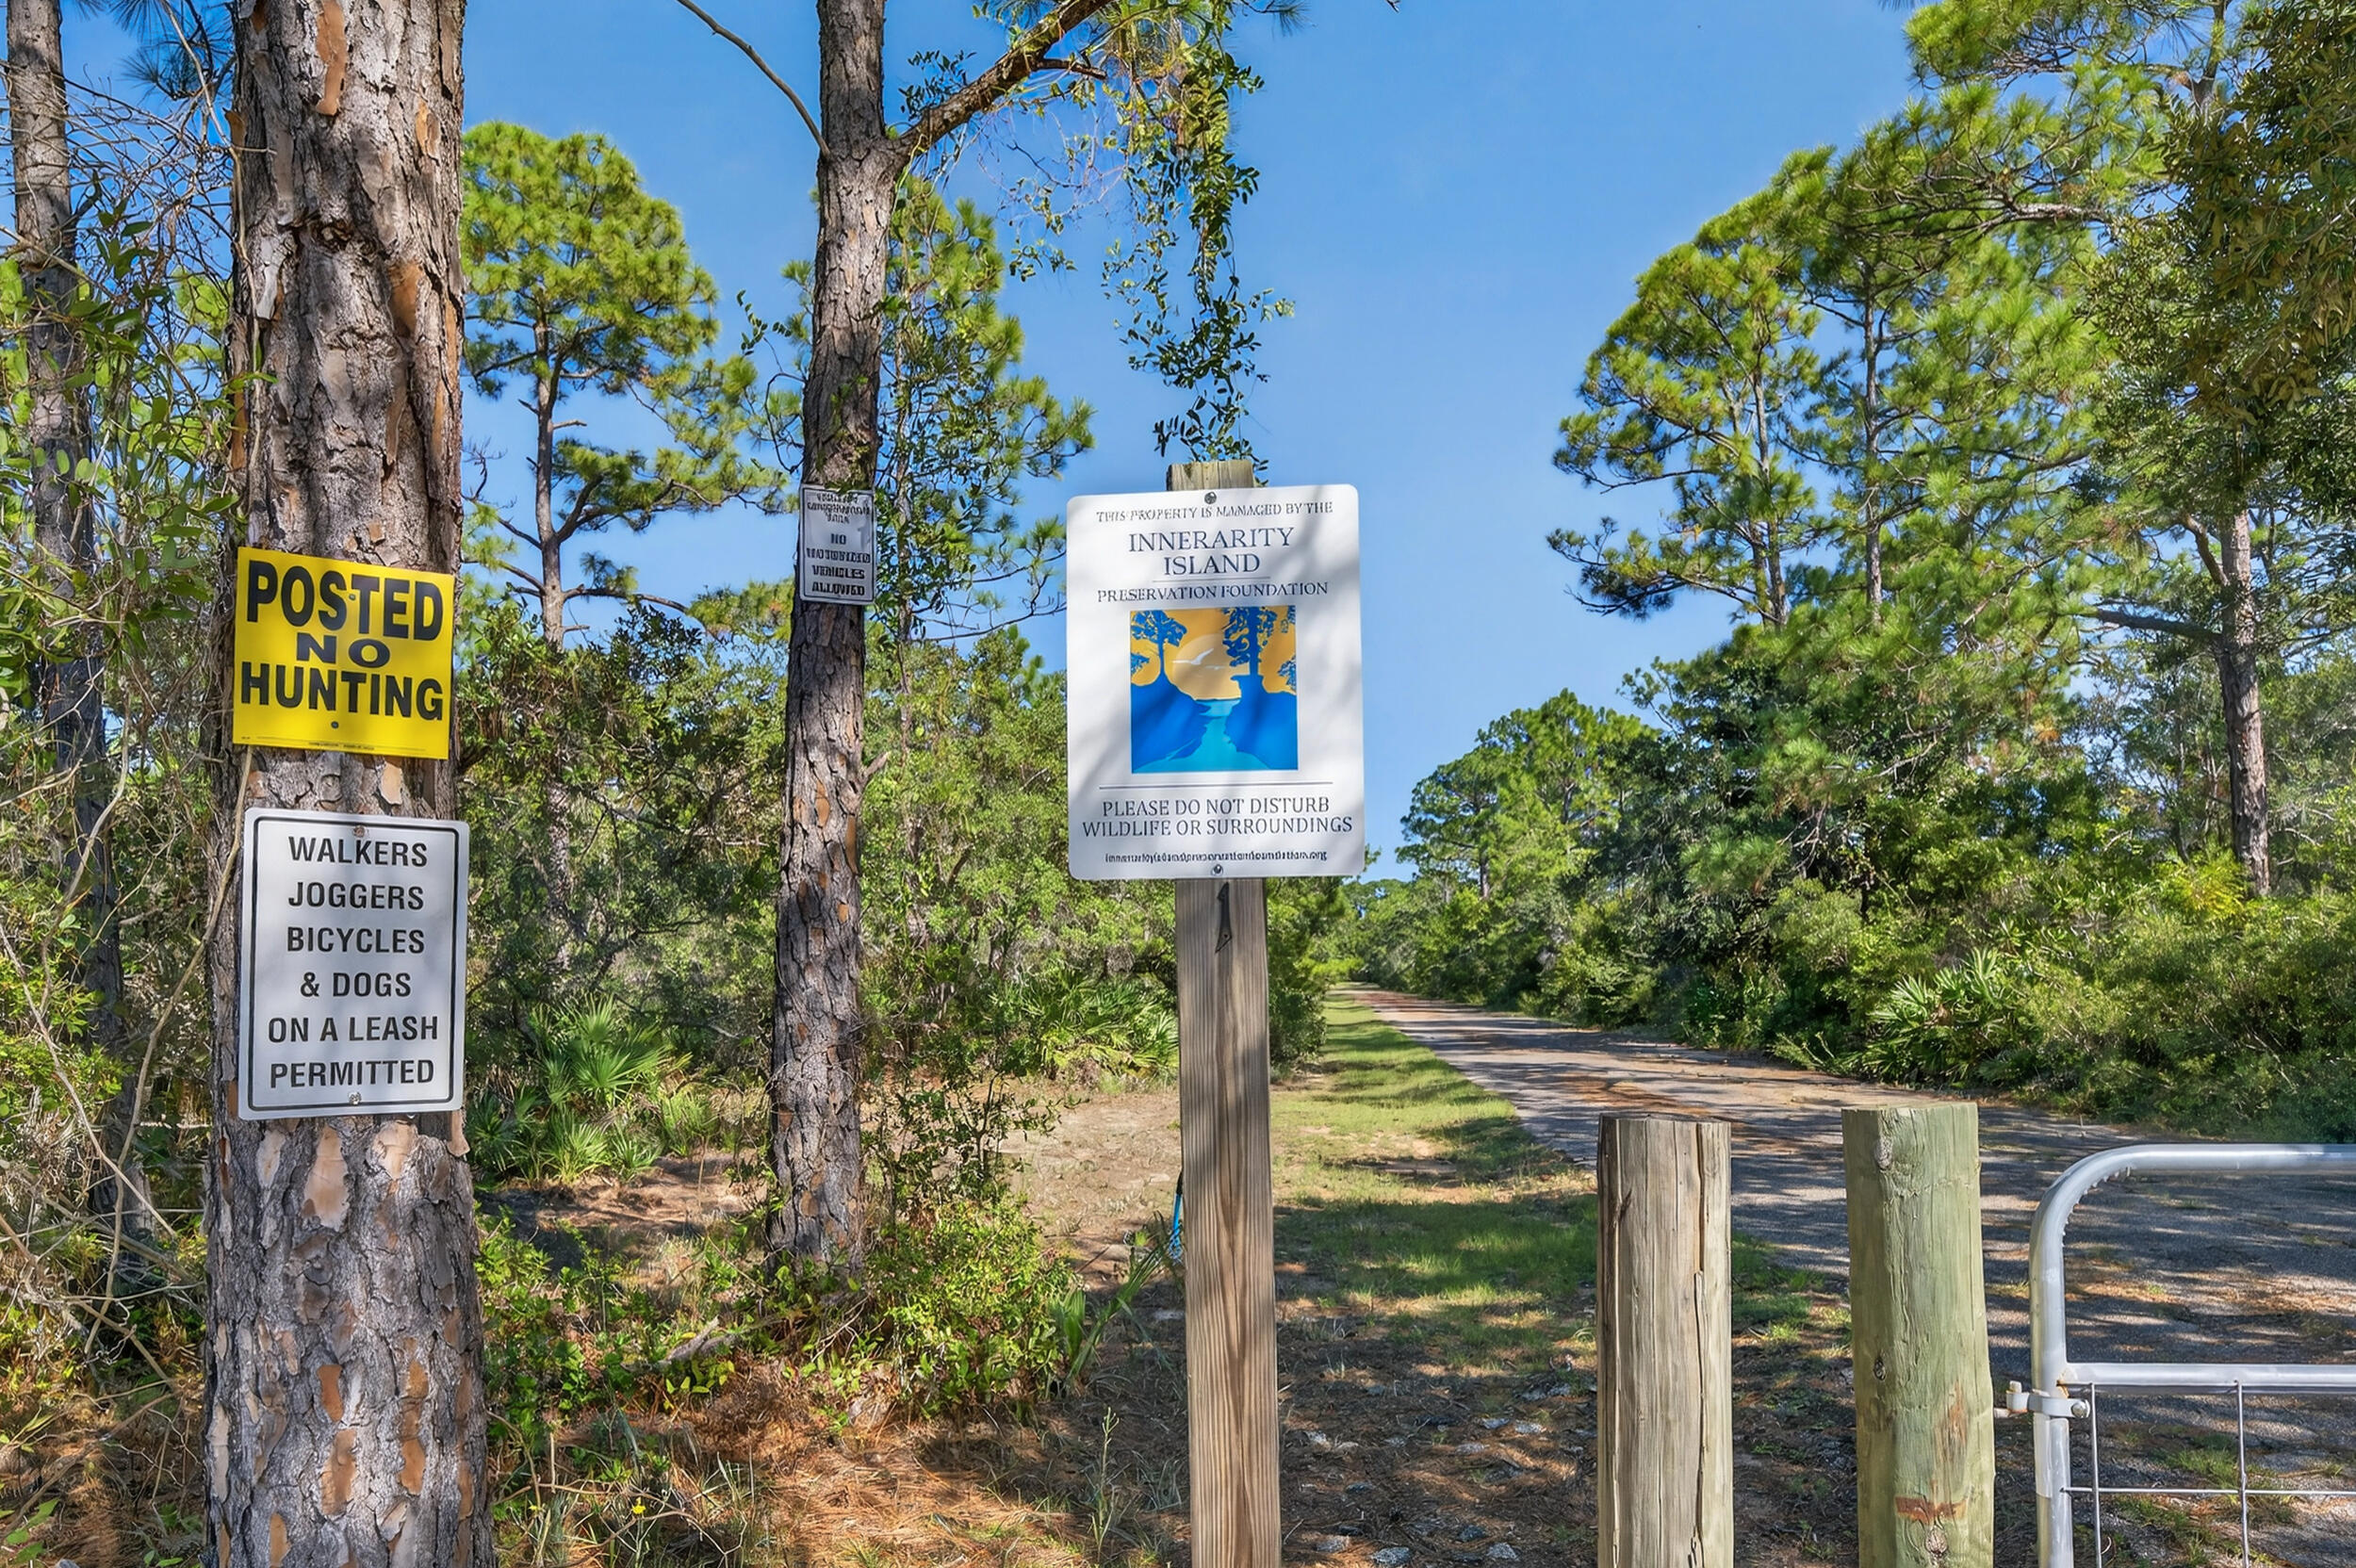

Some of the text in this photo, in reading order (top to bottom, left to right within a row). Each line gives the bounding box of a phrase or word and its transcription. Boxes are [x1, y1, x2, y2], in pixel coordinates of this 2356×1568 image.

[1097, 502, 1333, 523] THIS PROPERTY IS MANAGED BY THE
[830, 533, 846, 545] NO
[1129, 527, 1294, 552] INNERARITY
[1164, 553, 1260, 575] ISLAND
[247, 560, 443, 641] POSTED
[1098, 582, 1328, 602] PRESERVATION FOUNDATION
[297, 632, 390, 667] NO
[241, 662, 443, 720] HUNTING
[1103, 797, 1329, 817] PLEASE DO NOT DISTURB
[1082, 816, 1352, 838] WILDLIFE OR SURROUNDINGS
[288, 836, 428, 867] WALKERS
[288, 882, 424, 909] JOGGERS
[287, 926, 425, 954] BICYCLES
[300, 972, 412, 997] & DOGS
[269, 1016, 438, 1043] ON A LEASH
[270, 1060, 434, 1088] PERMITTED
